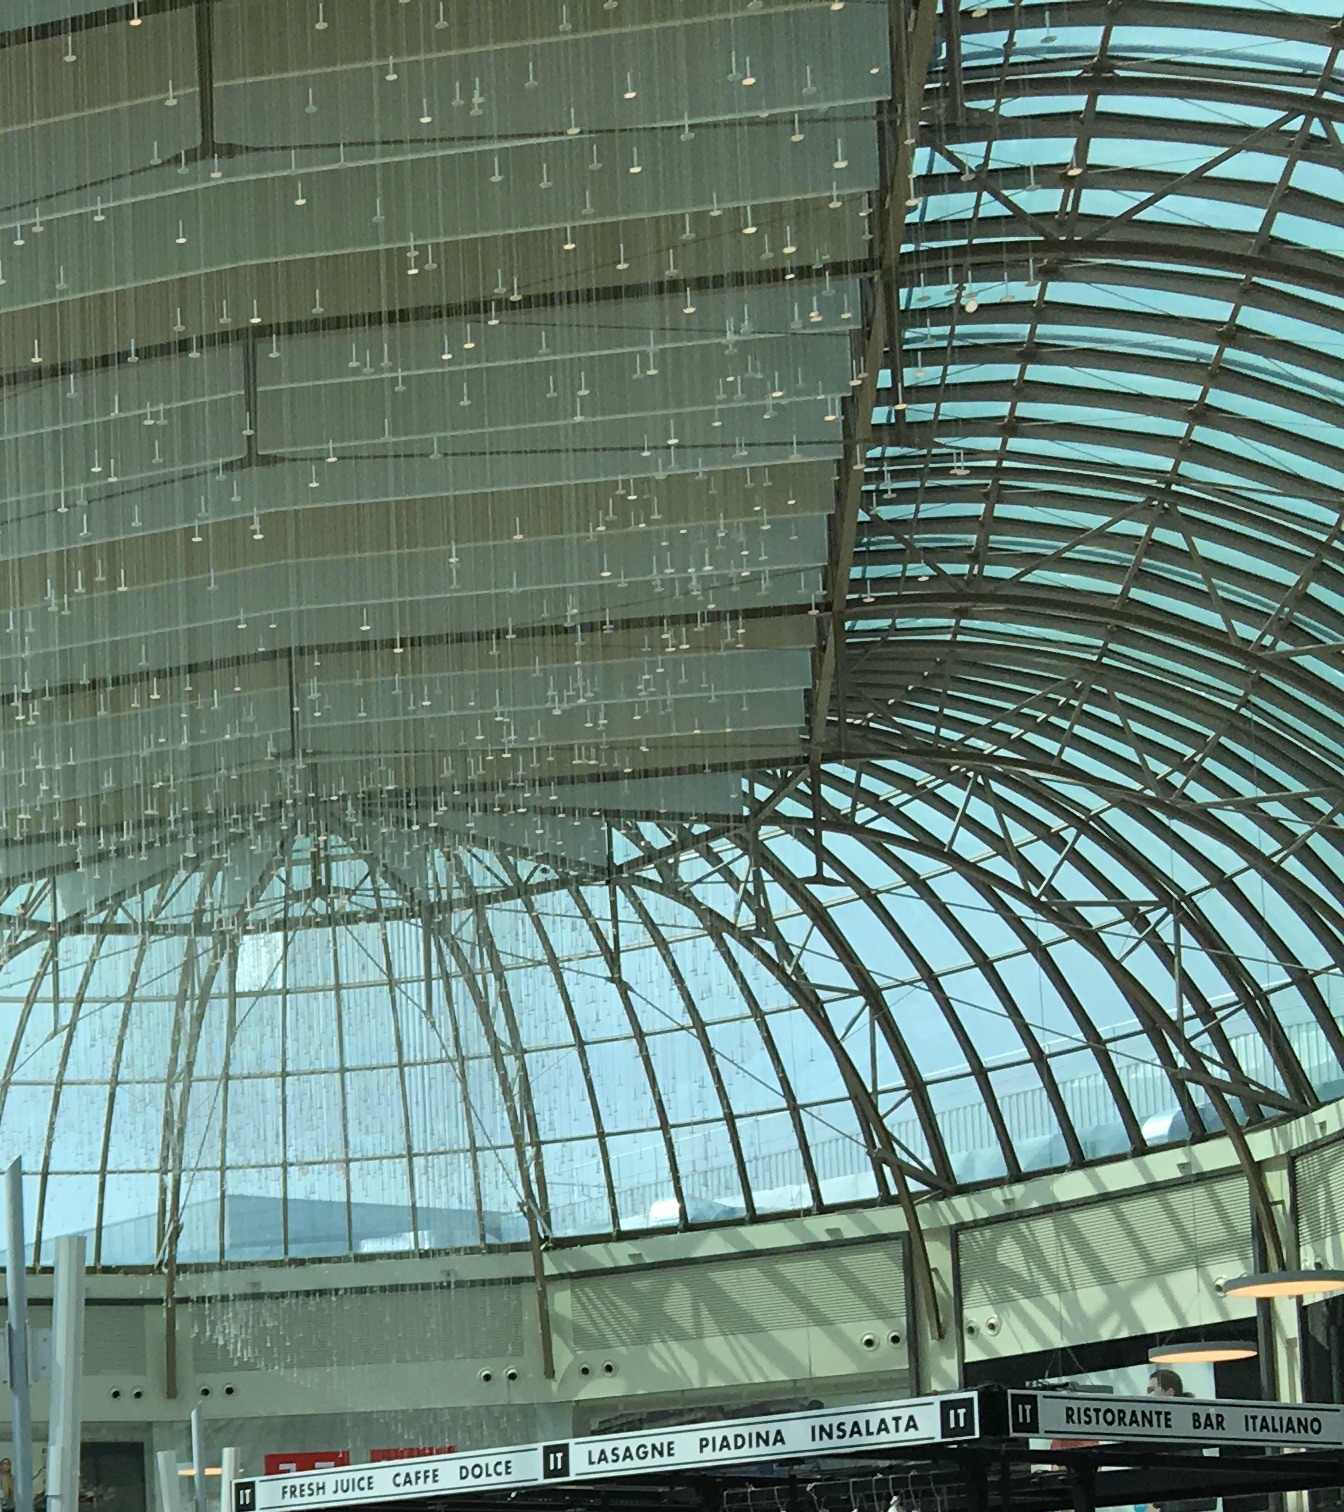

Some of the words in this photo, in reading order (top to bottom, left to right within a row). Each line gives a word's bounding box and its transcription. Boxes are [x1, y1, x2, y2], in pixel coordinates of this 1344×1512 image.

[549, 1451, 564, 1471] IT
[588, 1440, 676, 1466] LASAGNE
[699, 1429, 786, 1454] PIADINA
[811, 1414, 919, 1442] INSALATA
[949, 1407, 966, 1429] IT
[1018, 1404, 1032, 1424] IT
[1065, 1406, 1172, 1429] RISTORANTE
[1192, 1412, 1226, 1431] BAR
[1245, 1414, 1322, 1436] ITALIANO
[239, 1487, 252, 1506] IT
[281, 1480, 326, 1500] FRESH
[332, 1476, 374, 1495] JUICE
[392, 1468, 440, 1489] CAFFE
[459, 1459, 513, 1481] DOLCE
